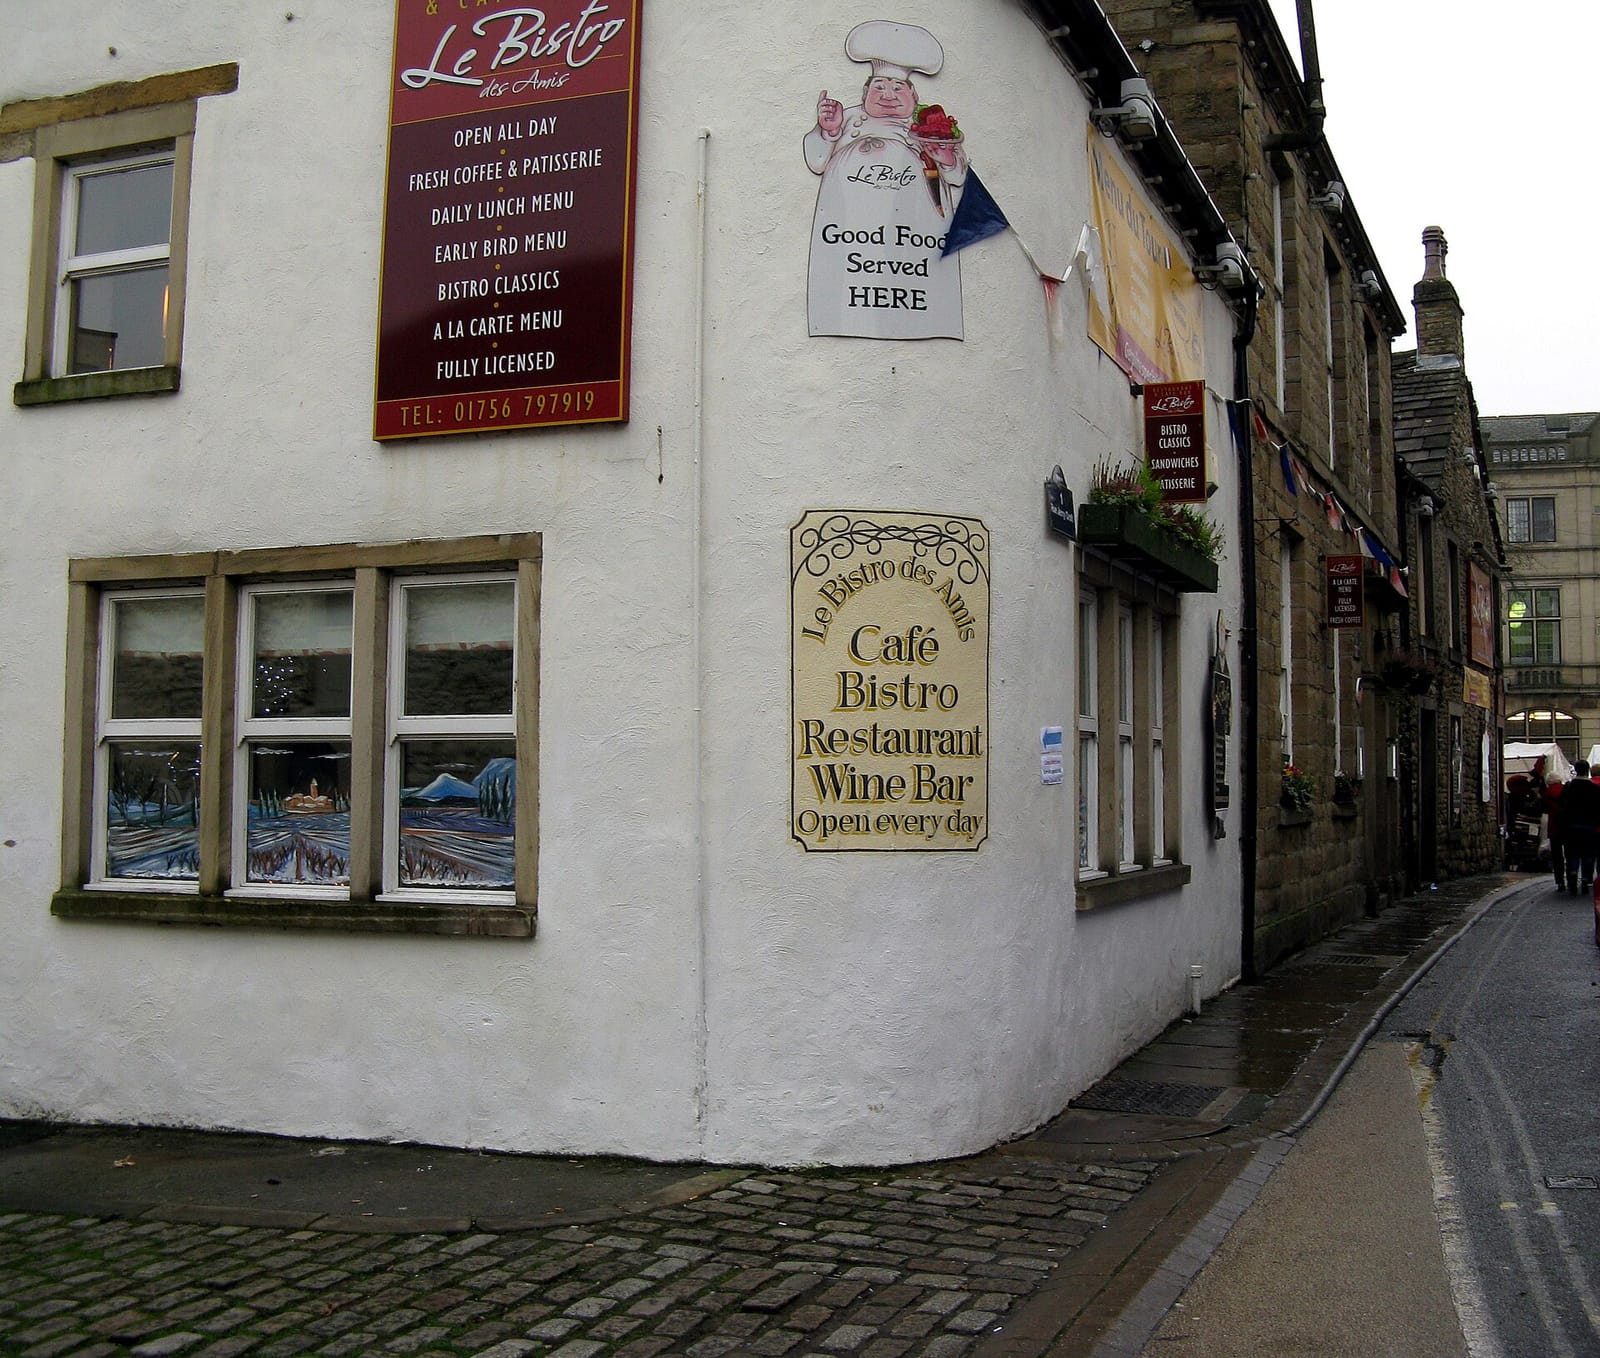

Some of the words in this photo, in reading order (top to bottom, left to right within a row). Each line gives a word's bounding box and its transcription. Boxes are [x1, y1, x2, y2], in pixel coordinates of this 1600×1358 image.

[400, 25, 483, 88] Le
[472, 0, 626, 70] Bistro
[479, 80, 509, 98] des
[511, 69, 570, 93] Amis
[453, 126, 493, 148] OPEN
[497, 121, 523, 142] ALL
[528, 116, 558, 138] DAY
[408, 169, 450, 192] FRESH
[453, 162, 503, 185] COFFEE
[507, 161, 519, 178] &
[522, 148, 603, 176] PATISSERIE
[847, 165, 875, 185] Le
[870, 164, 917, 187] Bistro
[431, 202, 472, 226] DAILY
[476, 196, 526, 220] LUNCH
[531, 190, 575, 212] MENU
[434, 240, 478, 264] EARLY
[482, 236, 519, 258] BIRD
[524, 230, 568, 253] MENU
[821, 223, 885, 245] Good
[846, 252, 929, 277] Served
[437, 278, 490, 302] BISTRO
[494, 270, 560, 295] CLASSICS
[847, 286, 928, 311] HERE
[433, 322, 443, 341] A
[448, 320, 465, 339] LA
[470, 314, 515, 337] CARTE
[520, 309, 563, 332] MENU
[436, 358, 479, 380] FULLY
[484, 351, 556, 376] LICENSED
[400, 405, 443, 427] TEL:
[454, 398, 512, 422] 01756
[523, 390, 595, 417] 797919
[1151, 399, 1169, 411] Le
[1158, 437, 1191, 449] CLASSICS
[1161, 424, 1187, 435] BISTRO
[1151, 457, 1199, 470] SANDWICHES
[1160, 478, 1196, 489] ATISSERIE
[817, 559, 896, 612] Bistro
[901, 556, 937, 586] des
[802, 606, 833, 645] Le
[933, 577, 976, 642] Amis
[848, 624, 940, 666] Café
[833, 670, 959, 711] Bistro
[797, 719, 983, 759] Restaurant
[808, 763, 906, 804] Wine
[909, 763, 974, 805] Bar
[797, 809, 870, 842] Open
[875, 814, 943, 841] every
[946, 808, 984, 842] day
